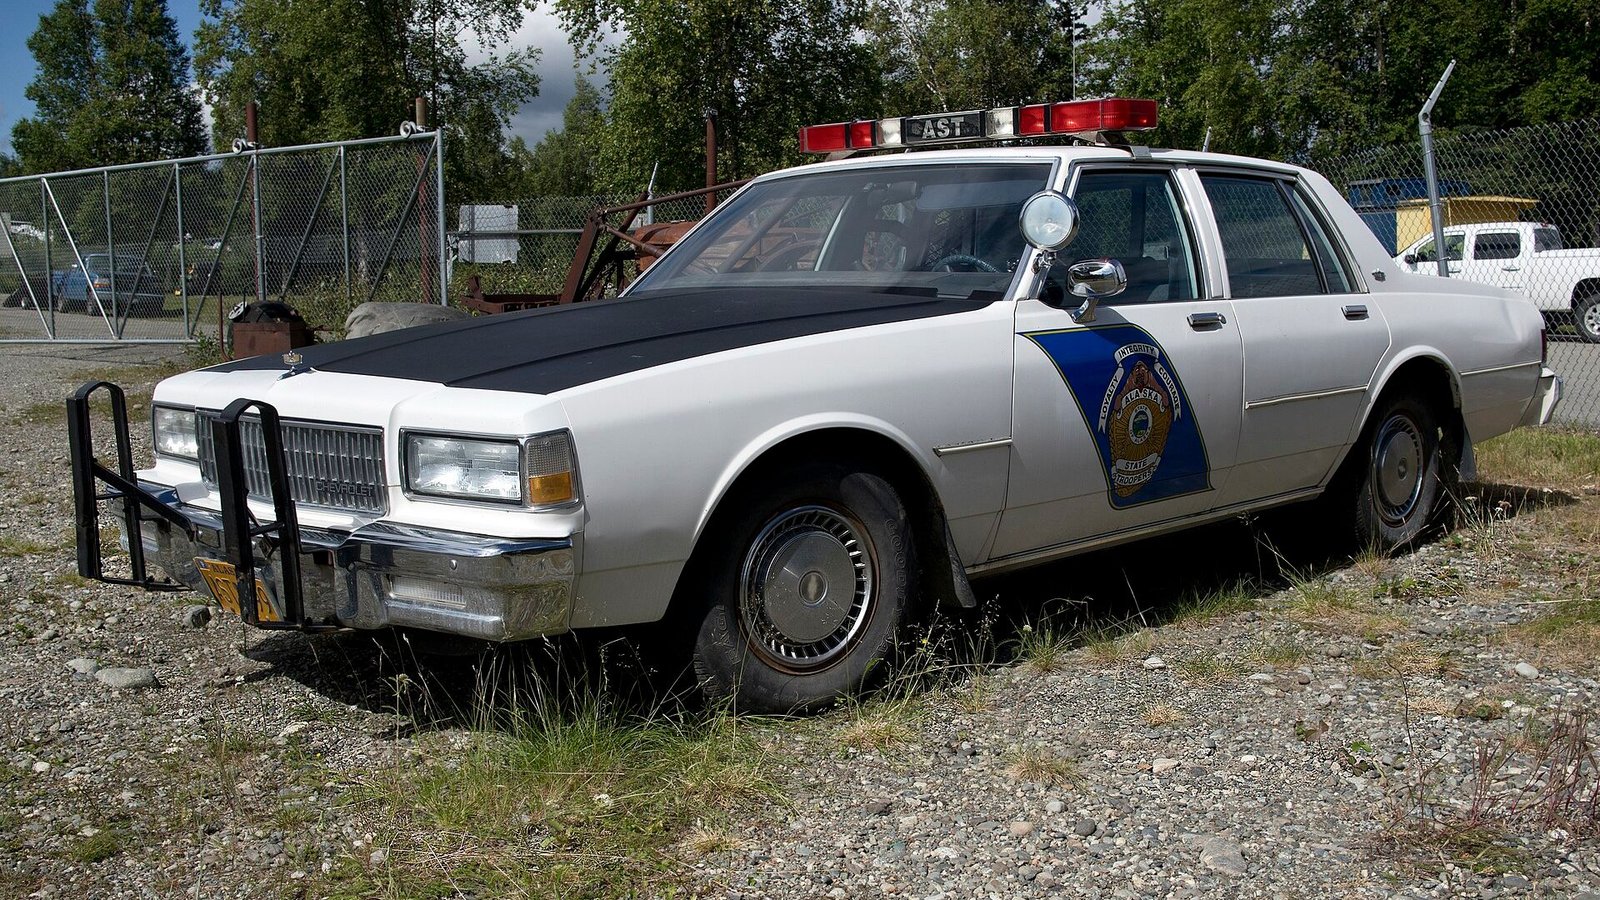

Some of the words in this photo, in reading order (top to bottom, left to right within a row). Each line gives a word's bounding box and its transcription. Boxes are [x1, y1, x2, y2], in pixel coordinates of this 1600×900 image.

[921, 116, 965, 139] AST
[1118, 344, 1155, 358] INTEGRITY
[1125, 388, 1159, 404] ALASKA
[1158, 367, 1180, 411] COURAGE
[1100, 375, 1120, 420] LOYALTY
[1125, 460, 1147, 470] STATE
[1116, 470, 1152, 484] TROOPERS
[316, 481, 374, 497] CHEVROLET
